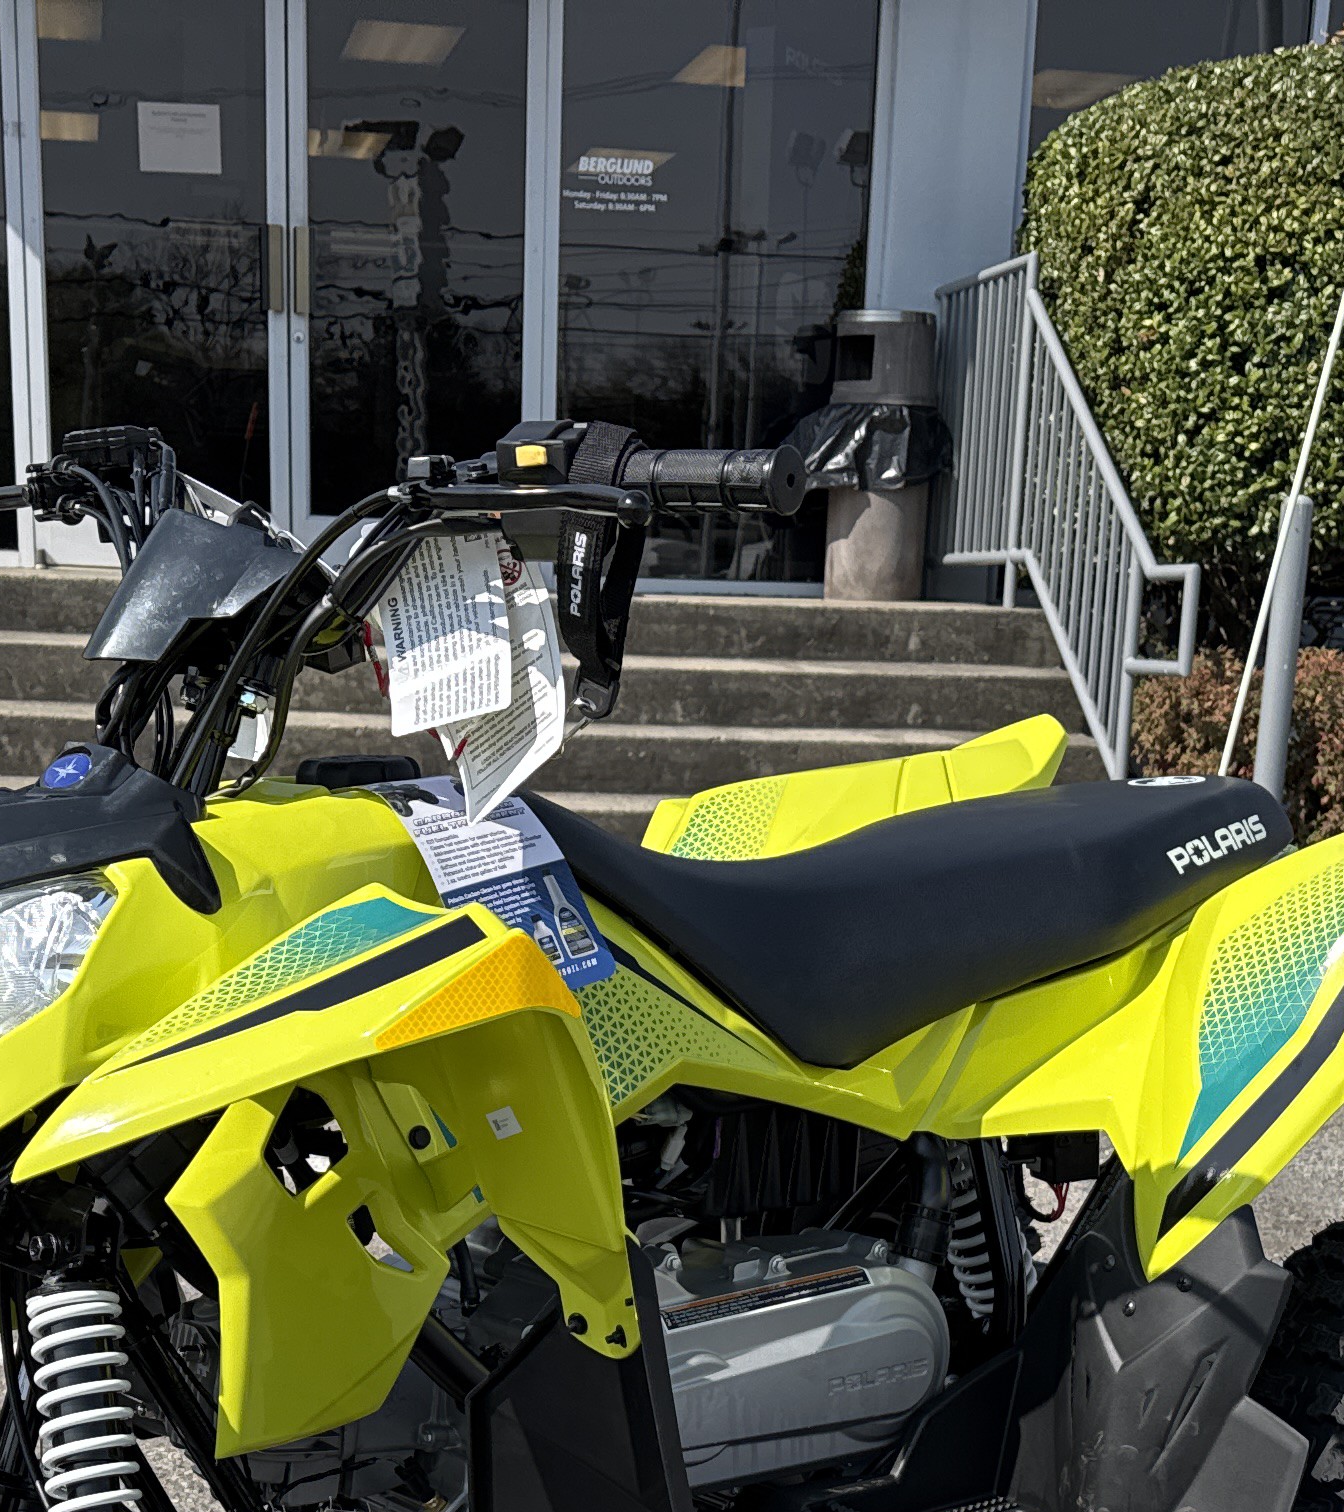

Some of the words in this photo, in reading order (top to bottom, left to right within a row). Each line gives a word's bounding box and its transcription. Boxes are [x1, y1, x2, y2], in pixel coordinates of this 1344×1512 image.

[578, 156, 654, 174] BERGLUND
[562, 189, 591, 199] Monday
[597, 174, 653, 187] OUTDOORS
[570, 531, 587, 617] POLARIS
[388, 596, 407, 662] WARNING
[413, 822, 447, 838] FUEL
[1166, 814, 1267, 875] POLARIS
[828, 1358, 928, 1397] POLARIS
